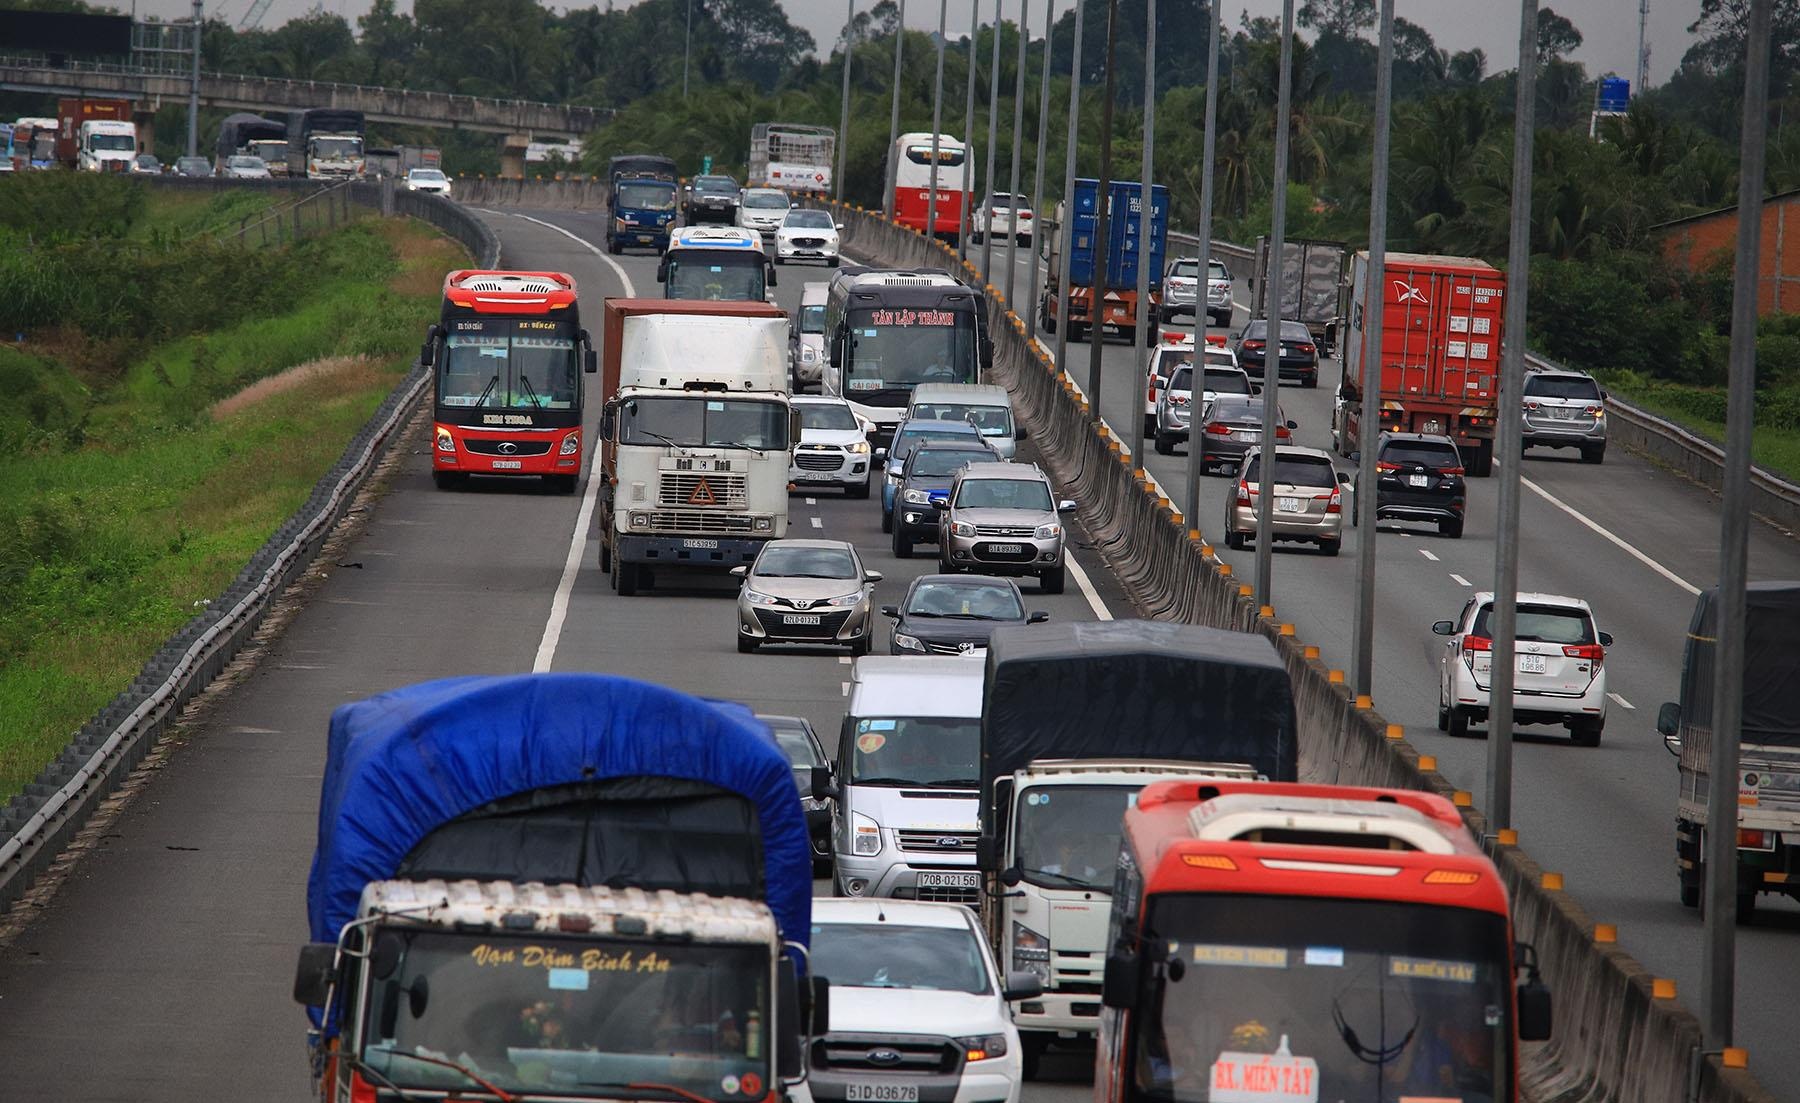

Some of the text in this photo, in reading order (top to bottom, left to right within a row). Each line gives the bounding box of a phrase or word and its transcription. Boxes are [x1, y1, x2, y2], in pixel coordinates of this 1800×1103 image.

[895, 309, 916, 328] LẬP
[483, 414, 533, 425] KIM THOA
[923, 875, 976, 886] 70B-021.56
[637, 952, 671, 973] An
